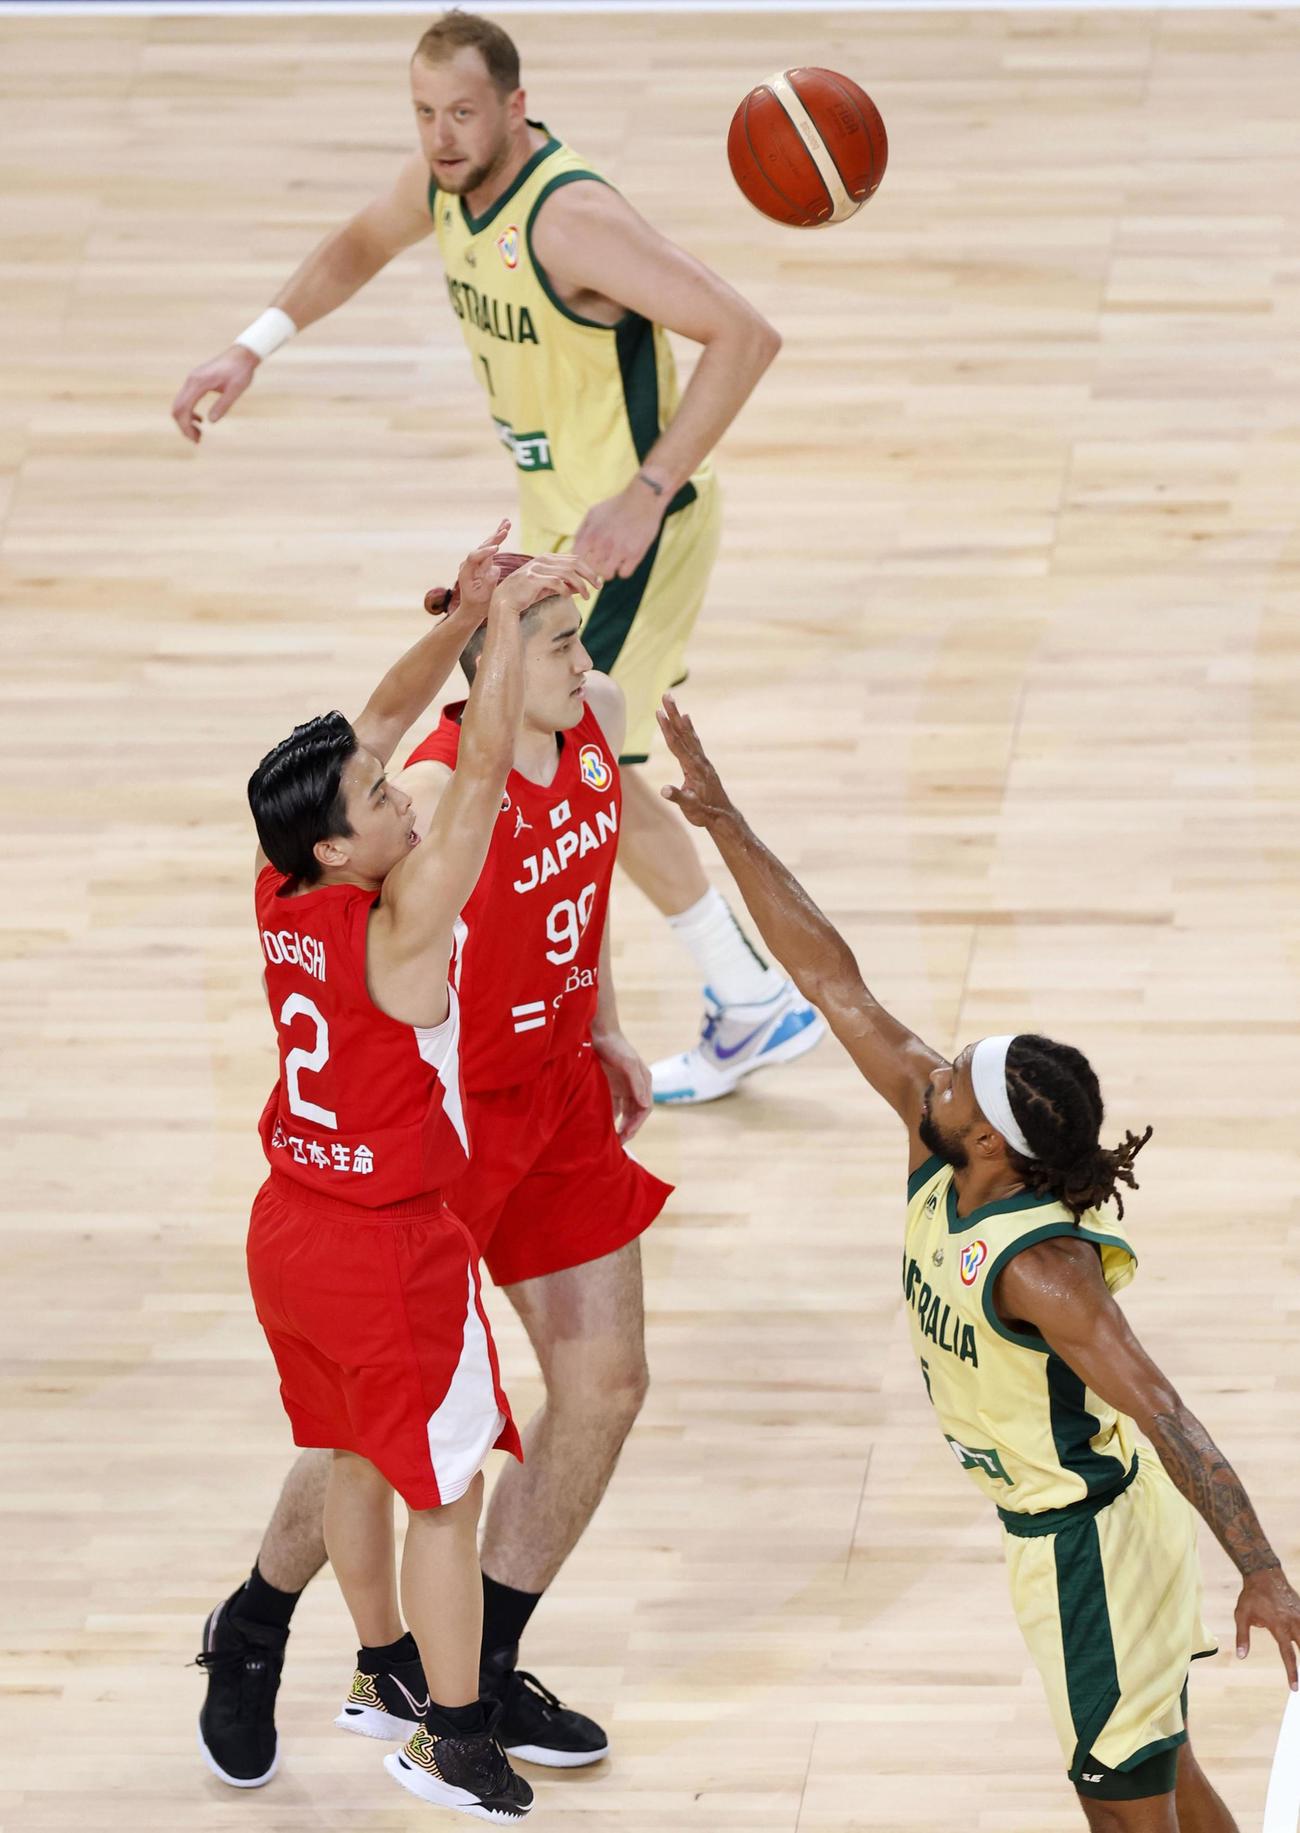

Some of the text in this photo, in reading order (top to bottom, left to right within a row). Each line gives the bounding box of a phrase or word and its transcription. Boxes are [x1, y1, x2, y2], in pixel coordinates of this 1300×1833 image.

[513, 801, 617, 895] JAPAN
[280, 992, 338, 1130] 2
[288, 1136, 374, 1175] 日本生命
